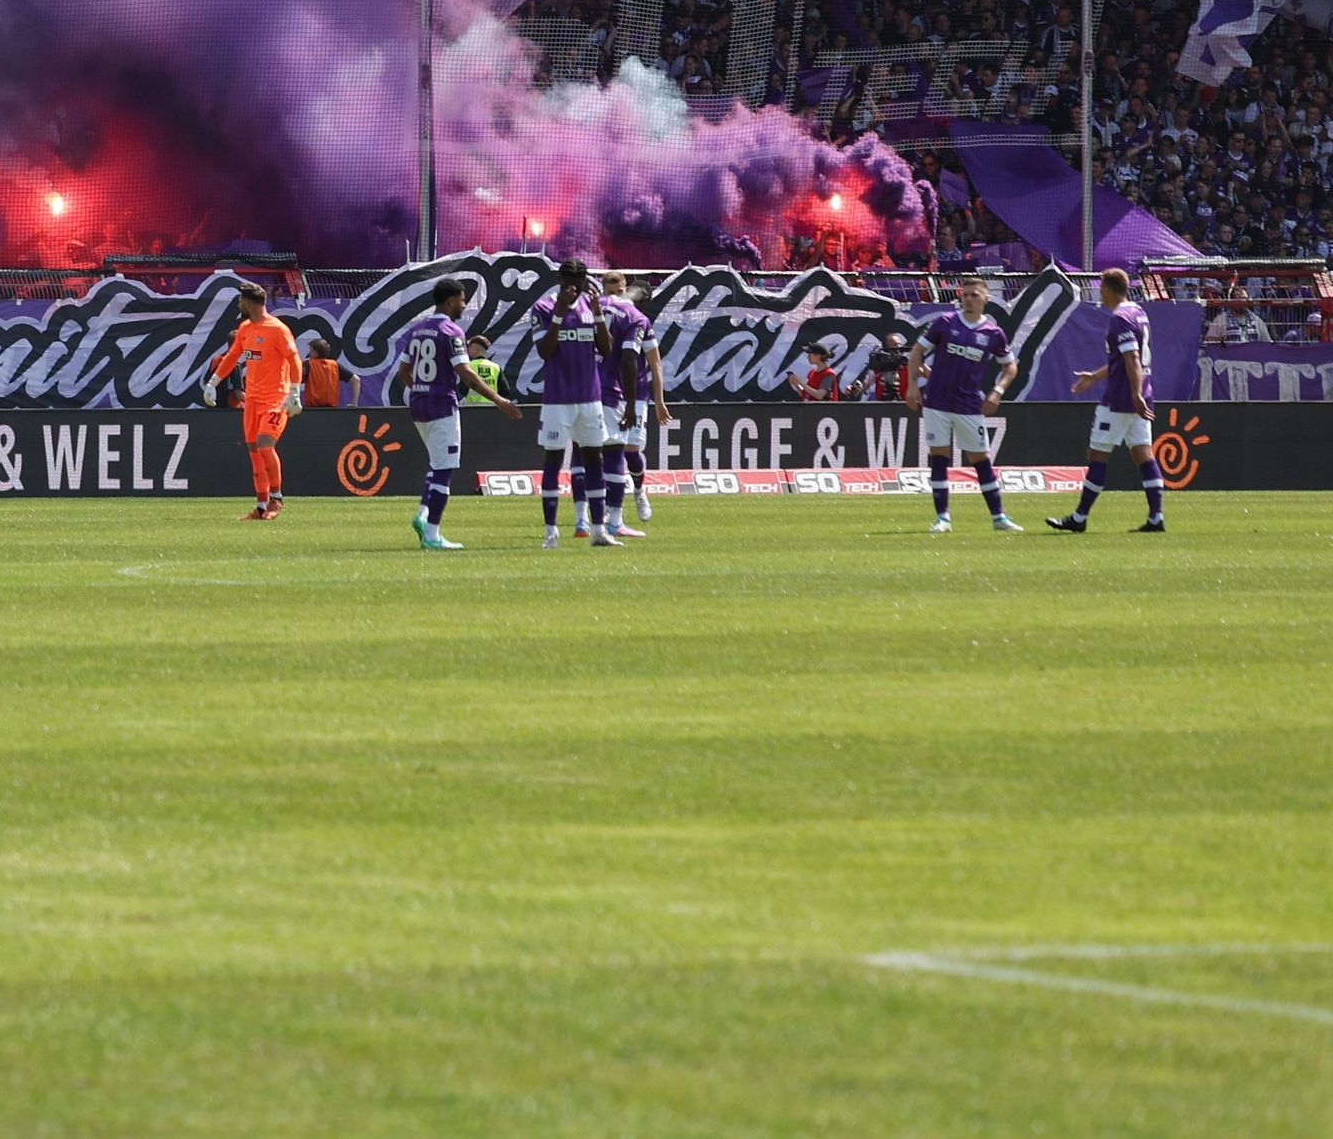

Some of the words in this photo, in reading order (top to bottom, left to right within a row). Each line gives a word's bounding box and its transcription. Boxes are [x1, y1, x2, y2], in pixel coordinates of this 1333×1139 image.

[42, 422, 190, 492] WELZ
[488, 473, 533, 496] SO
[695, 472, 740, 495] SO
[743, 482, 778, 494] TECH
[796, 471, 842, 494] SO
[843, 481, 880, 493] TECH
[1000, 470, 1046, 492] SO
[1049, 480, 1083, 492] TECH
